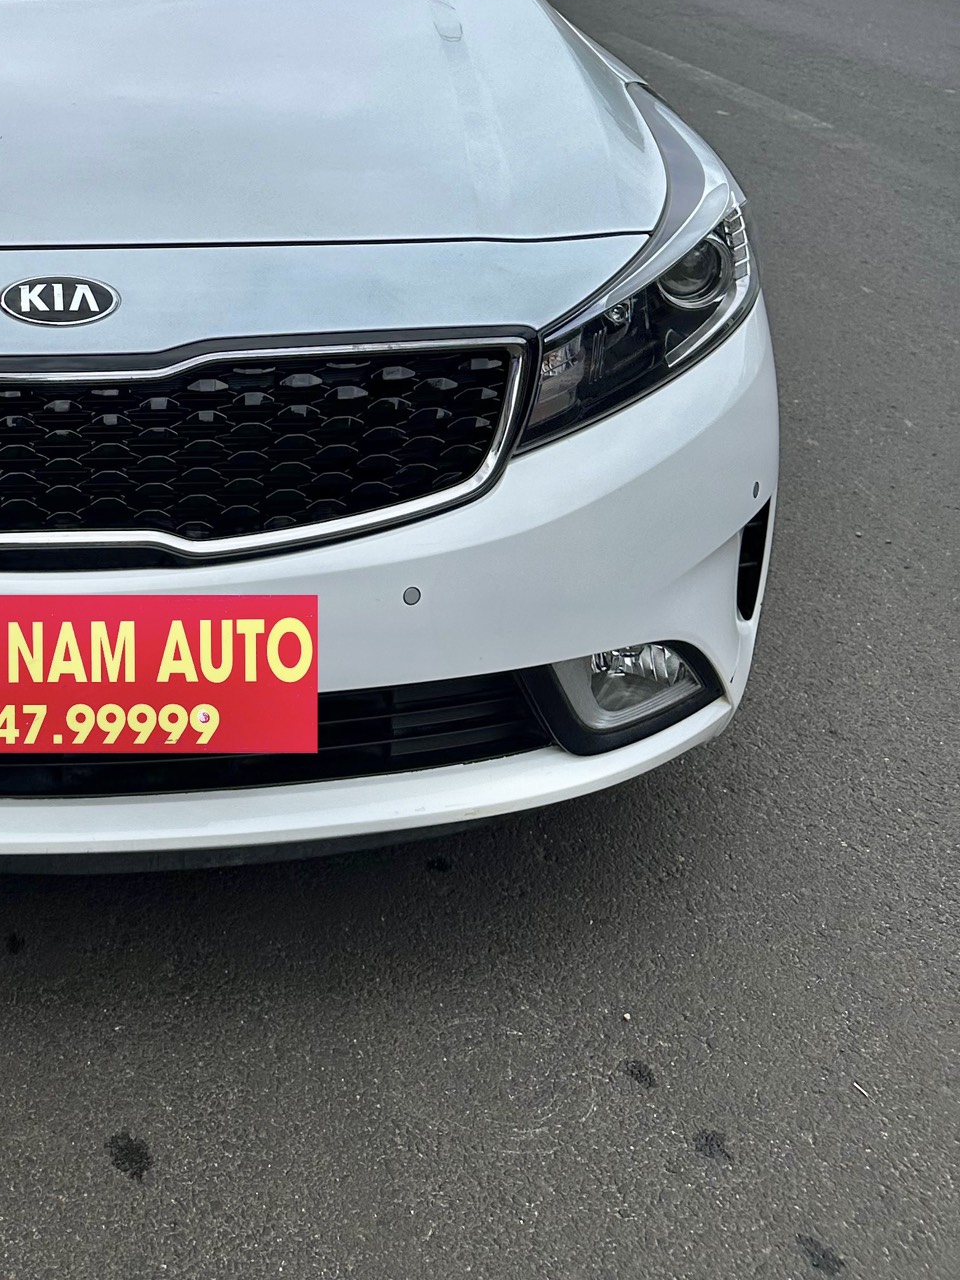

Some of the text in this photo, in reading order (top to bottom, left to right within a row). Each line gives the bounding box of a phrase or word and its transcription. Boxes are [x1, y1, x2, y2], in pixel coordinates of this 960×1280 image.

[19, 283, 100, 312] KIA
[7, 620, 137, 683] NAM
[156, 617, 314, 684] AUTO
